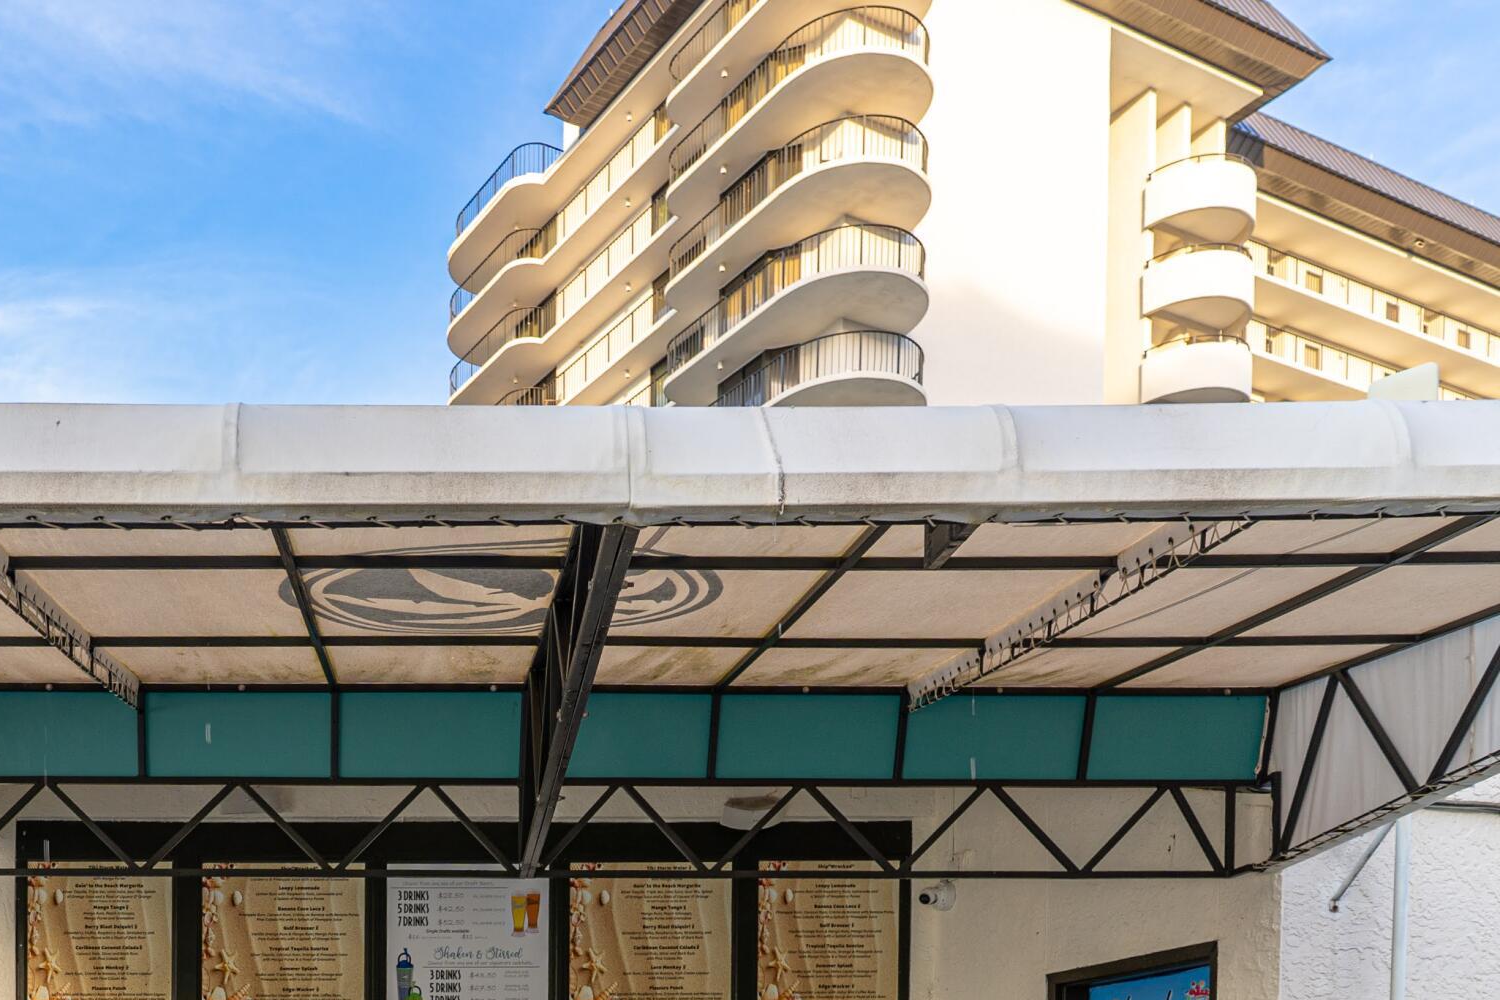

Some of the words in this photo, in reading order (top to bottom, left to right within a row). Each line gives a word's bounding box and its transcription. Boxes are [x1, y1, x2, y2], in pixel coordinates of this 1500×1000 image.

[398, 890, 402, 900] 3
[404, 890, 429, 900] DRINKS
[398, 904, 402, 913] 5
[404, 904, 429, 913] DRINKS
[398, 917, 402, 927] 7
[403, 917, 428, 926] DRINKS
[430, 970, 435, 979] 3
[436, 970, 461, 979] DRINKS
[430, 983, 434, 992] 5
[436, 983, 461, 992] DRINKS
